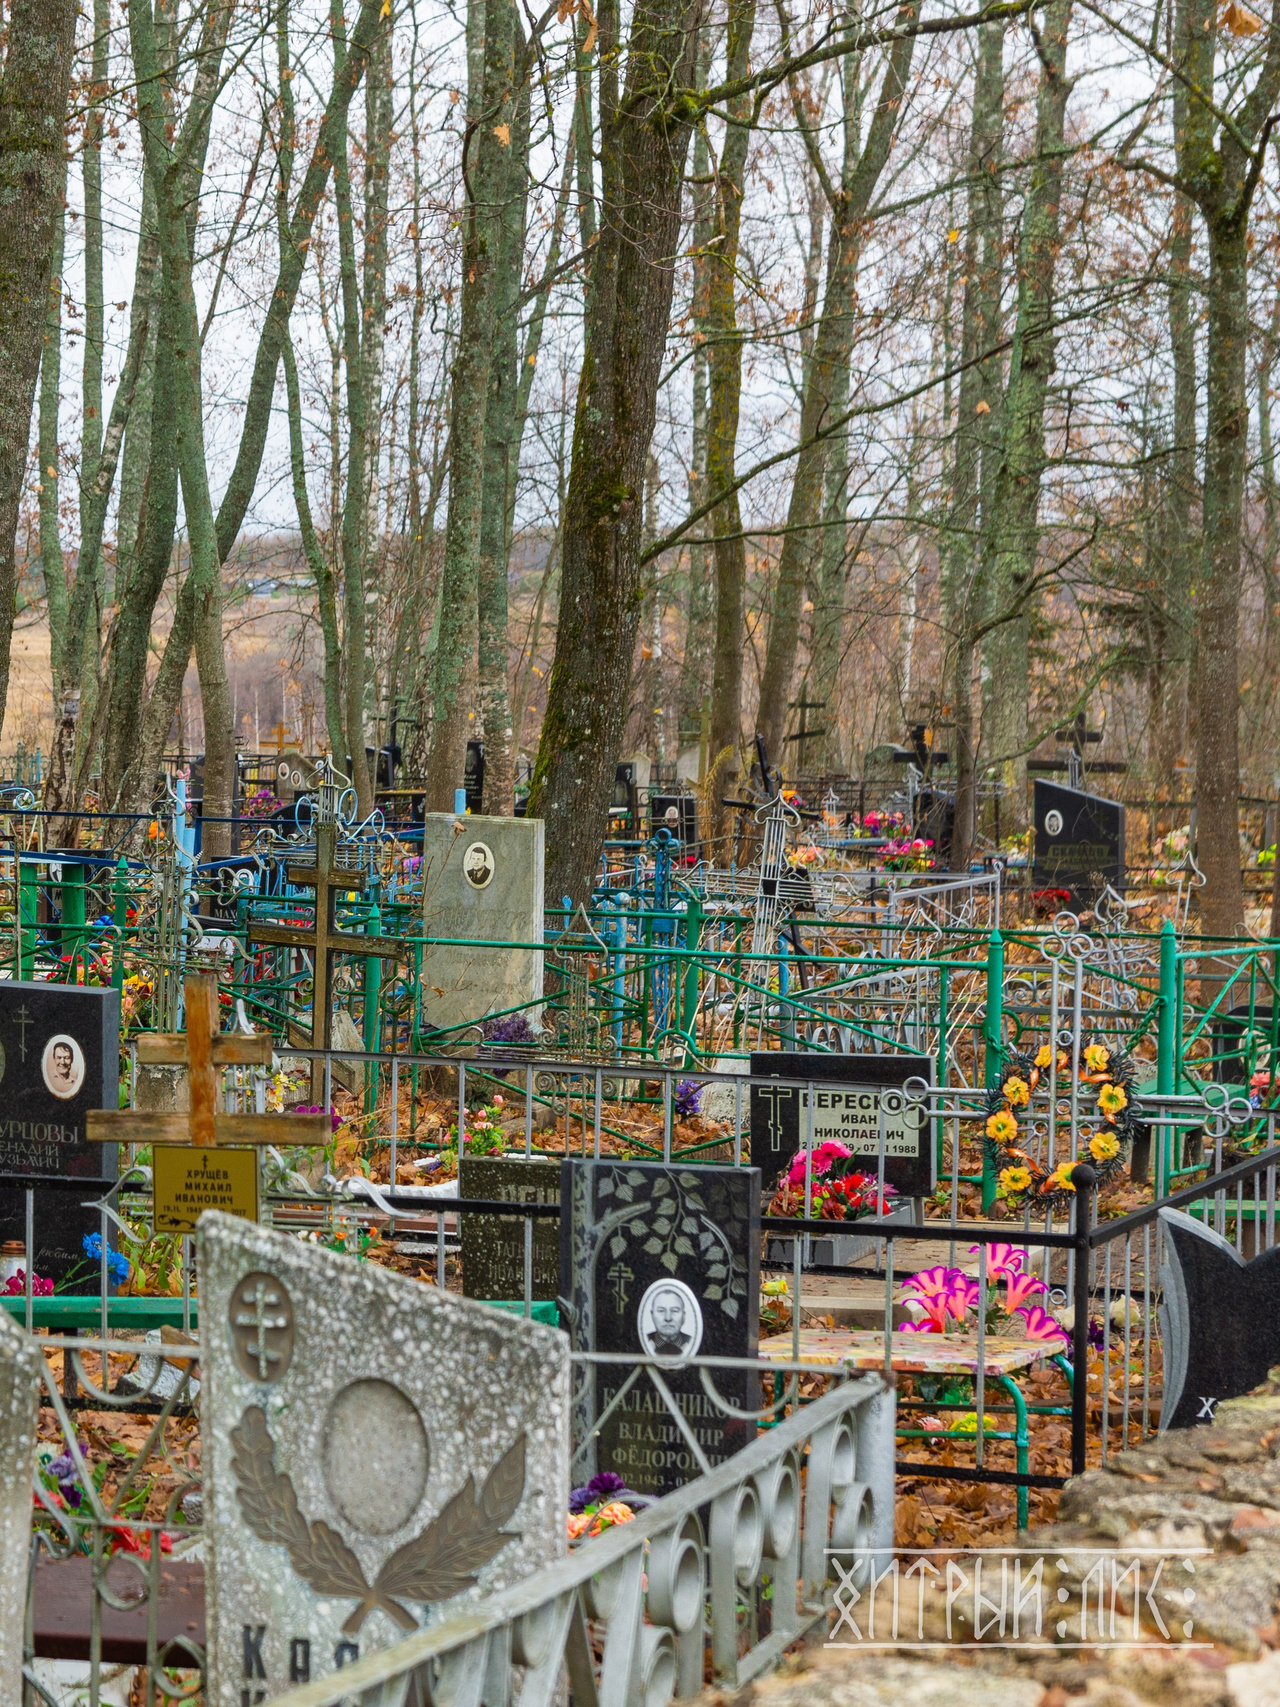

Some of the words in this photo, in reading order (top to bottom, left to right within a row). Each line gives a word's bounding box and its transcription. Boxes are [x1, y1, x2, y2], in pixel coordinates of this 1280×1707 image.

[841, 1113, 877, 1125] ИВАН
[892, 1144, 916, 1154] 1988
[186, 1169, 229, 1181] ХРУЩЁВ
[184, 1181, 232, 1193] МИХАИЛ
[175, 1193, 234, 1206] ИВАНОВИЧ
